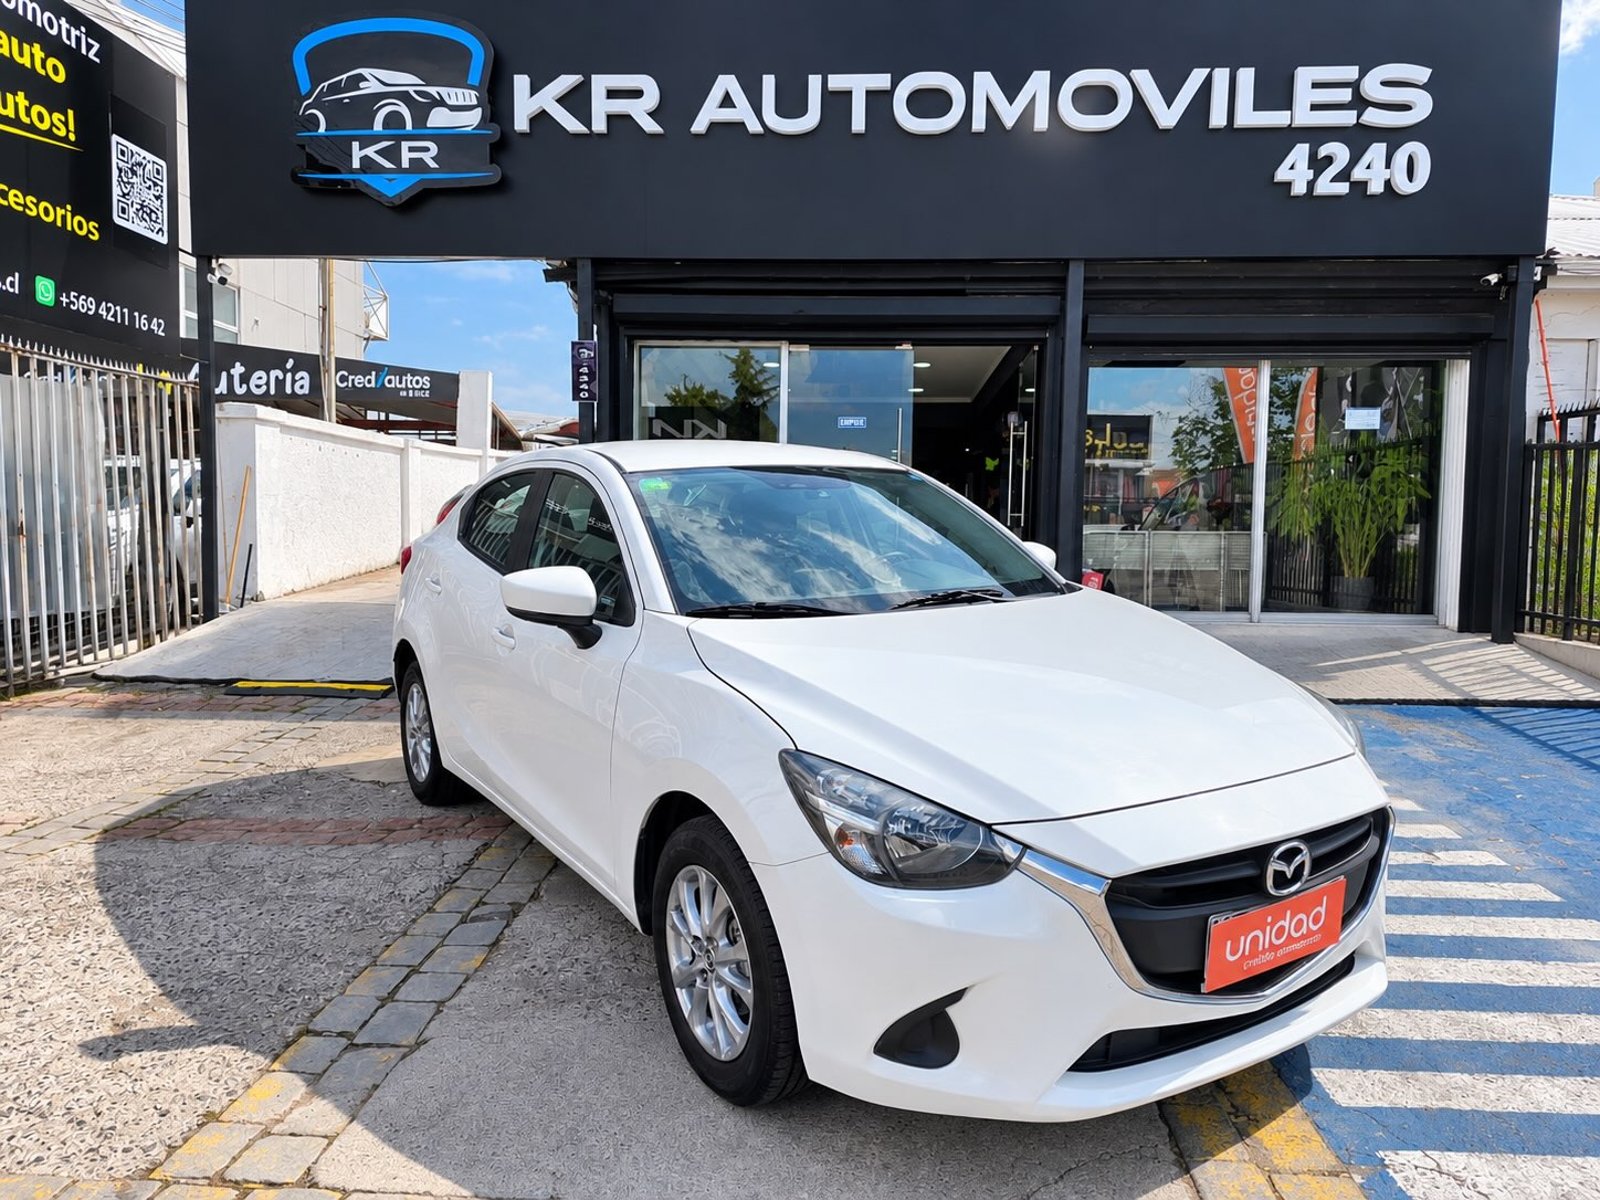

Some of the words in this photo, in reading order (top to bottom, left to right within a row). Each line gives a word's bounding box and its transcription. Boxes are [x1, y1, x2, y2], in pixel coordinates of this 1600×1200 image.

[509, 72, 664, 135] KR
[690, 63, 1434, 135] AUTOMOVILES
[350, 139, 440, 170] KR
[1273, 141, 1432, 196] 4240
[59, 291, 96, 315] +569
[98, 301, 129, 326] 4211
[133, 311, 149, 331] 16
[150, 317, 166, 337] 42
[1225, 895, 1327, 962] unidad
